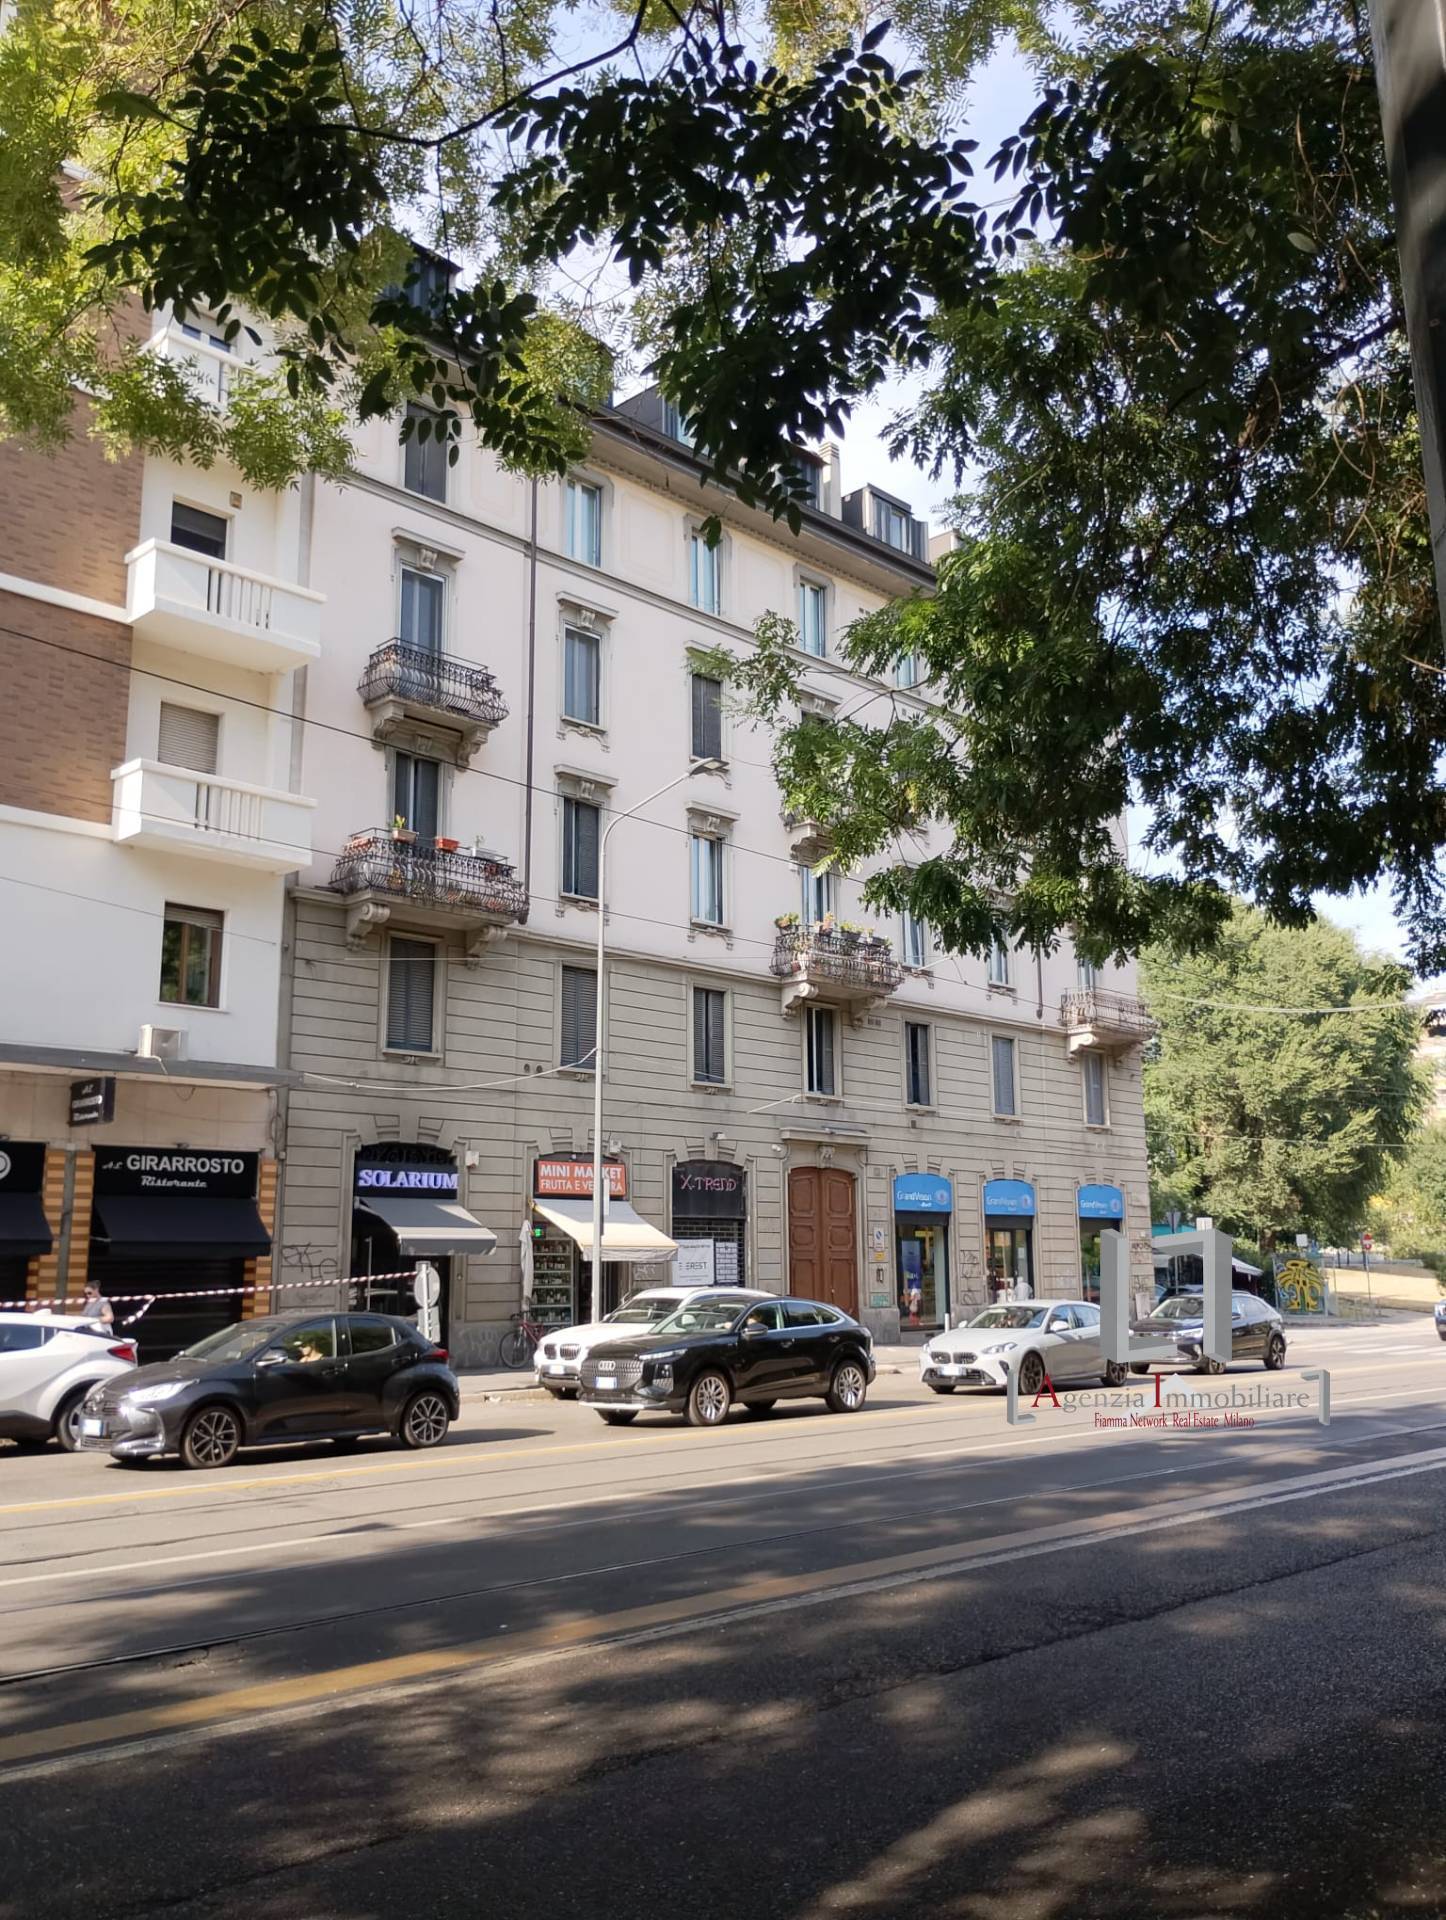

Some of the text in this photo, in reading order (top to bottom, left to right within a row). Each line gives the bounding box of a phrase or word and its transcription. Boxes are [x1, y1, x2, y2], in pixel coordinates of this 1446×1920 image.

[126, 1154, 245, 1174] GIRARROSTO
[541, 1164, 622, 1179] MINI MAKET
[140, 1175, 208, 1188] Ristorante
[358, 1169, 459, 1189] SOLARIUM
[541, 1179, 573, 1191] FRUTTA
[575, 1180, 580, 1191] E
